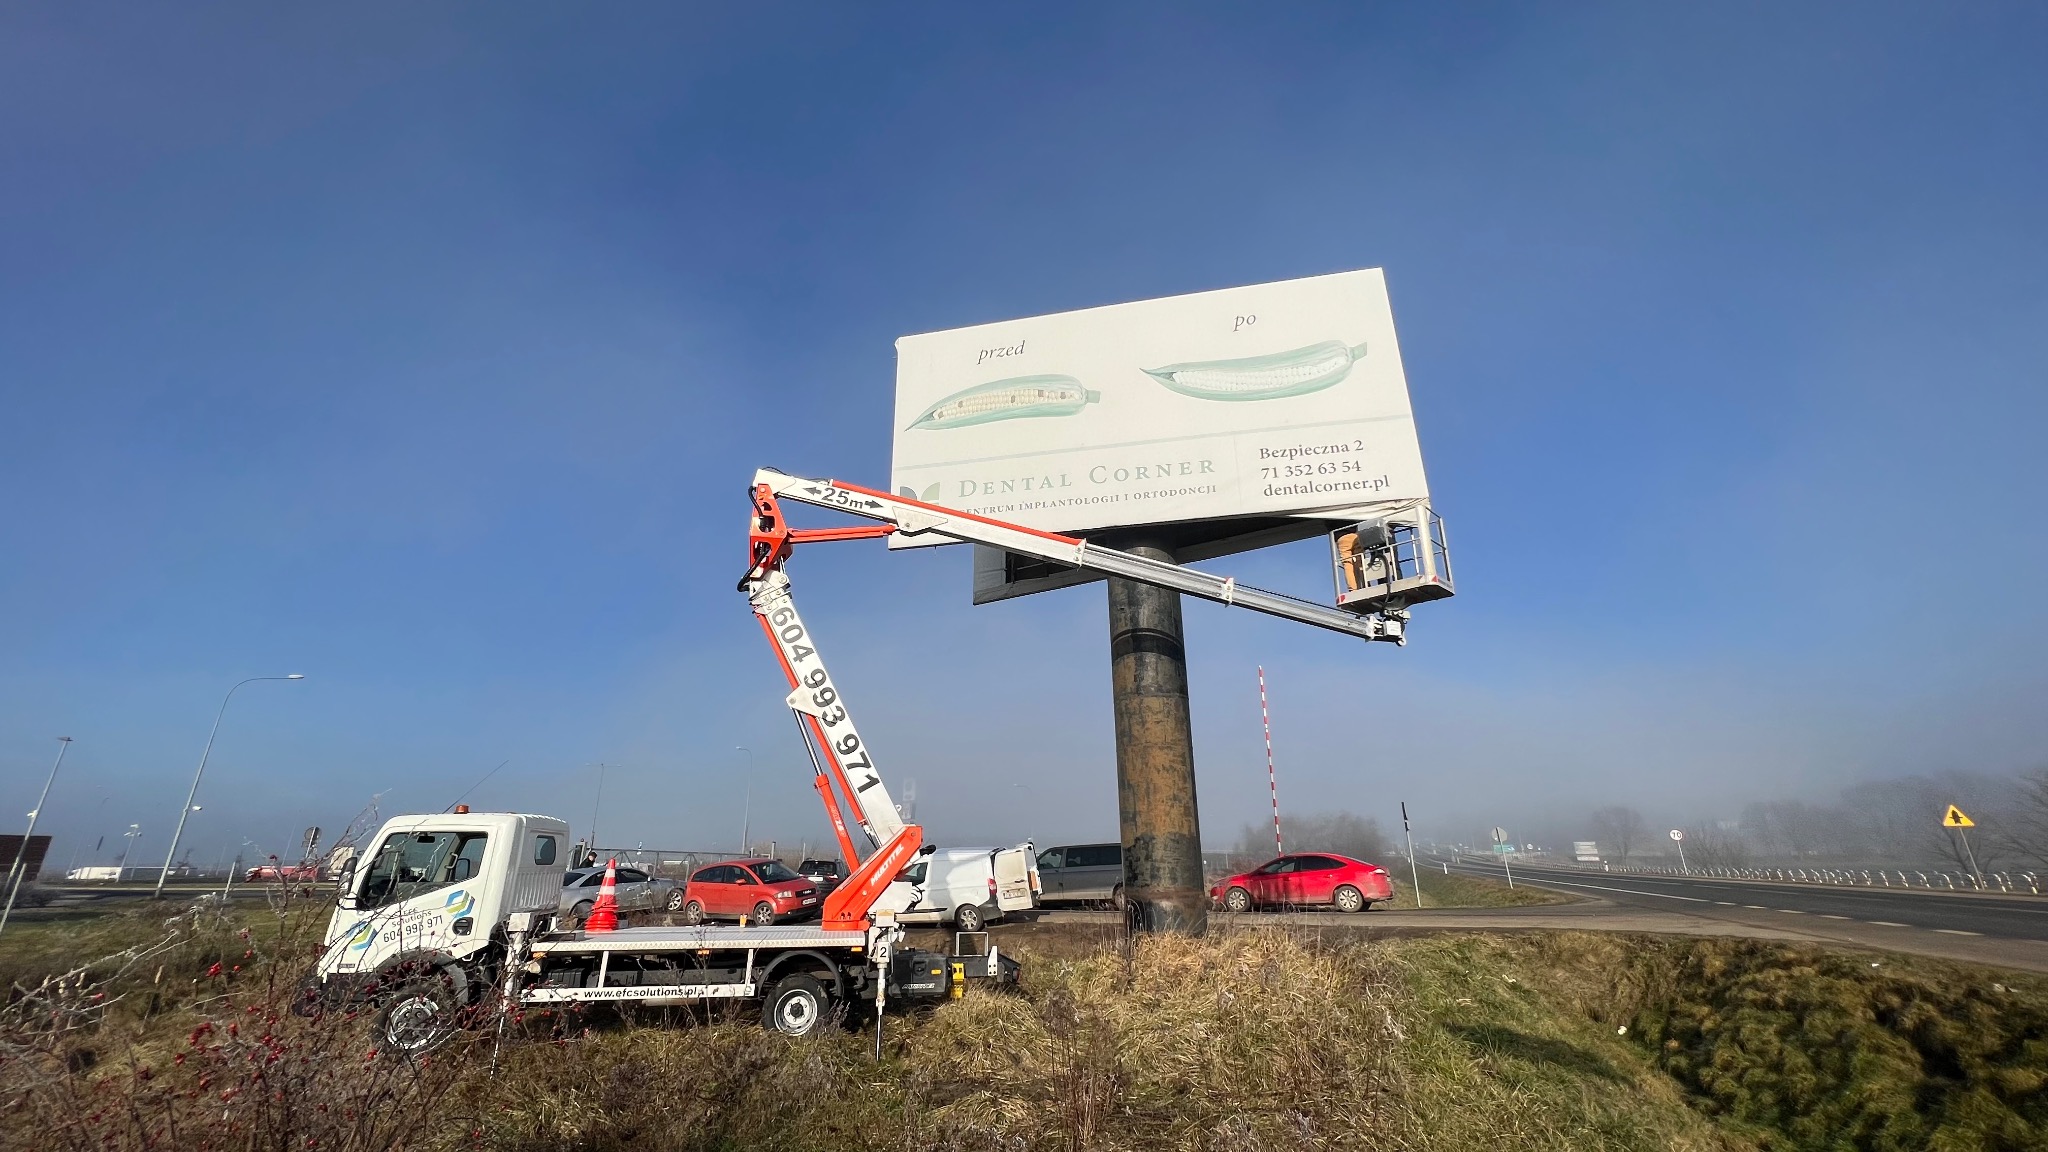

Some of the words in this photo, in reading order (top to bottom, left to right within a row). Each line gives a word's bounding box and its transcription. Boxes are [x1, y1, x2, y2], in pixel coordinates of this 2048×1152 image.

[1233, 314, 1257, 332] po
[976, 339, 1026, 365] przed
[1260, 442, 1350, 460] Bezpieczna
[1353, 439, 1364, 451] 2
[958, 473, 1073, 498] DENTAL
[1089, 459, 1216, 484] CORNER
[1260, 466, 1279, 480] 71
[1284, 464, 1314, 478] 352
[1318, 462, 1337, 475] 63
[1342, 460, 1362, 473] 54
[1263, 474, 1390, 497] dentalcorner.pl
[821, 487, 864, 509] 25m
[960, 504, 1014, 516] ENTRUM
[1018, 494, 1120, 511] IMPLANTOLOGII
[1124, 493, 1130, 502] I
[1133, 485, 1217, 500] ORTODONCJI
[771, 606, 815, 663] 604
[803, 668, 846, 727] 993
[835, 733, 880, 794] 971
[426, 914, 443, 928] 971
[879, 946, 887, 958] 2
[584, 986, 697, 999] www.efcsolutions.pl
